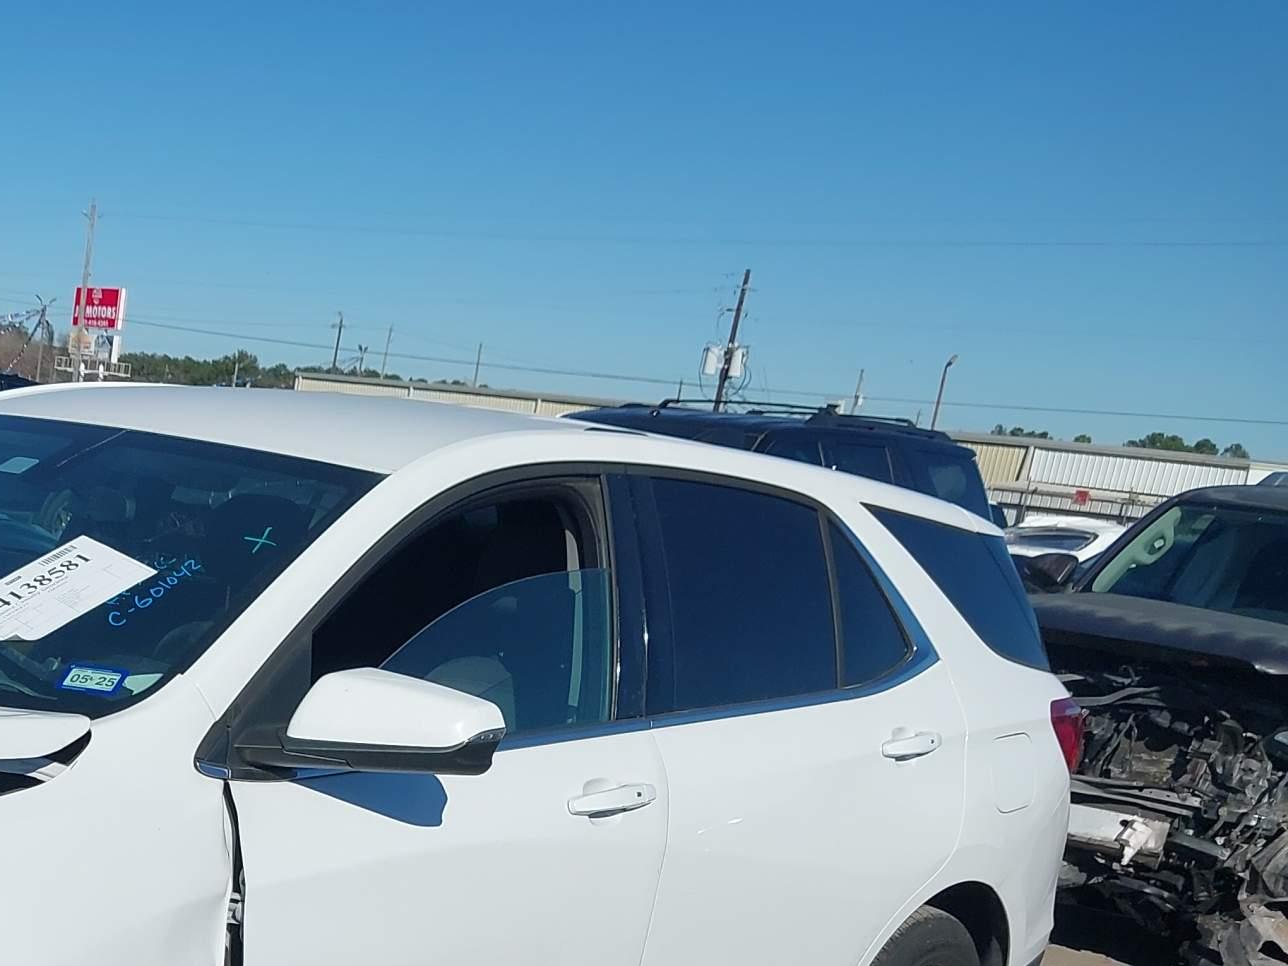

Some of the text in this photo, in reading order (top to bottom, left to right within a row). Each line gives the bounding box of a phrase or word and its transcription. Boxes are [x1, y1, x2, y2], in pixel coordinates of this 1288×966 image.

[85, 304, 117, 320] MOTORS
[69, 673, 90, 685] 05
[94, 676, 117, 688] 25
